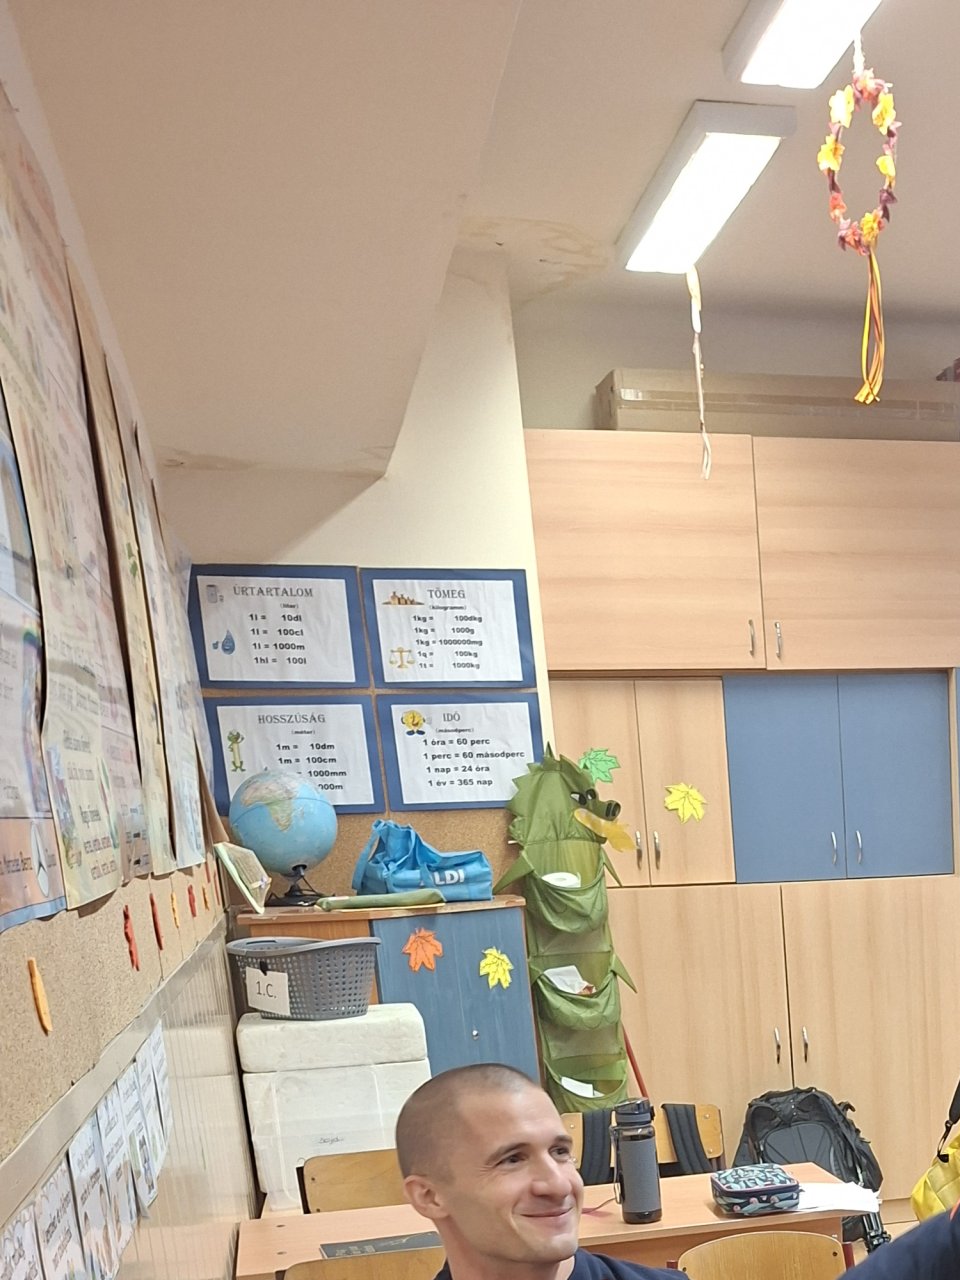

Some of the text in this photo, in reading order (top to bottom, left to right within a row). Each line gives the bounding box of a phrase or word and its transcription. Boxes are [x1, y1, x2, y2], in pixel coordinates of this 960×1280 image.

[427, 588, 466, 599] TÖMEG
[281, 614, 302, 622] 10dl
[413, 615, 427, 623] 1kg
[454, 615, 482, 623] 100dkg
[452, 662, 480, 670] 1000kg
[258, 712, 326, 724] HOSSZÚSÁG
[470, 738, 490, 746] perc
[432, 753, 452, 761] perc
[476, 751, 525, 760] másodperc
[424, 869, 465, 886] LDI
